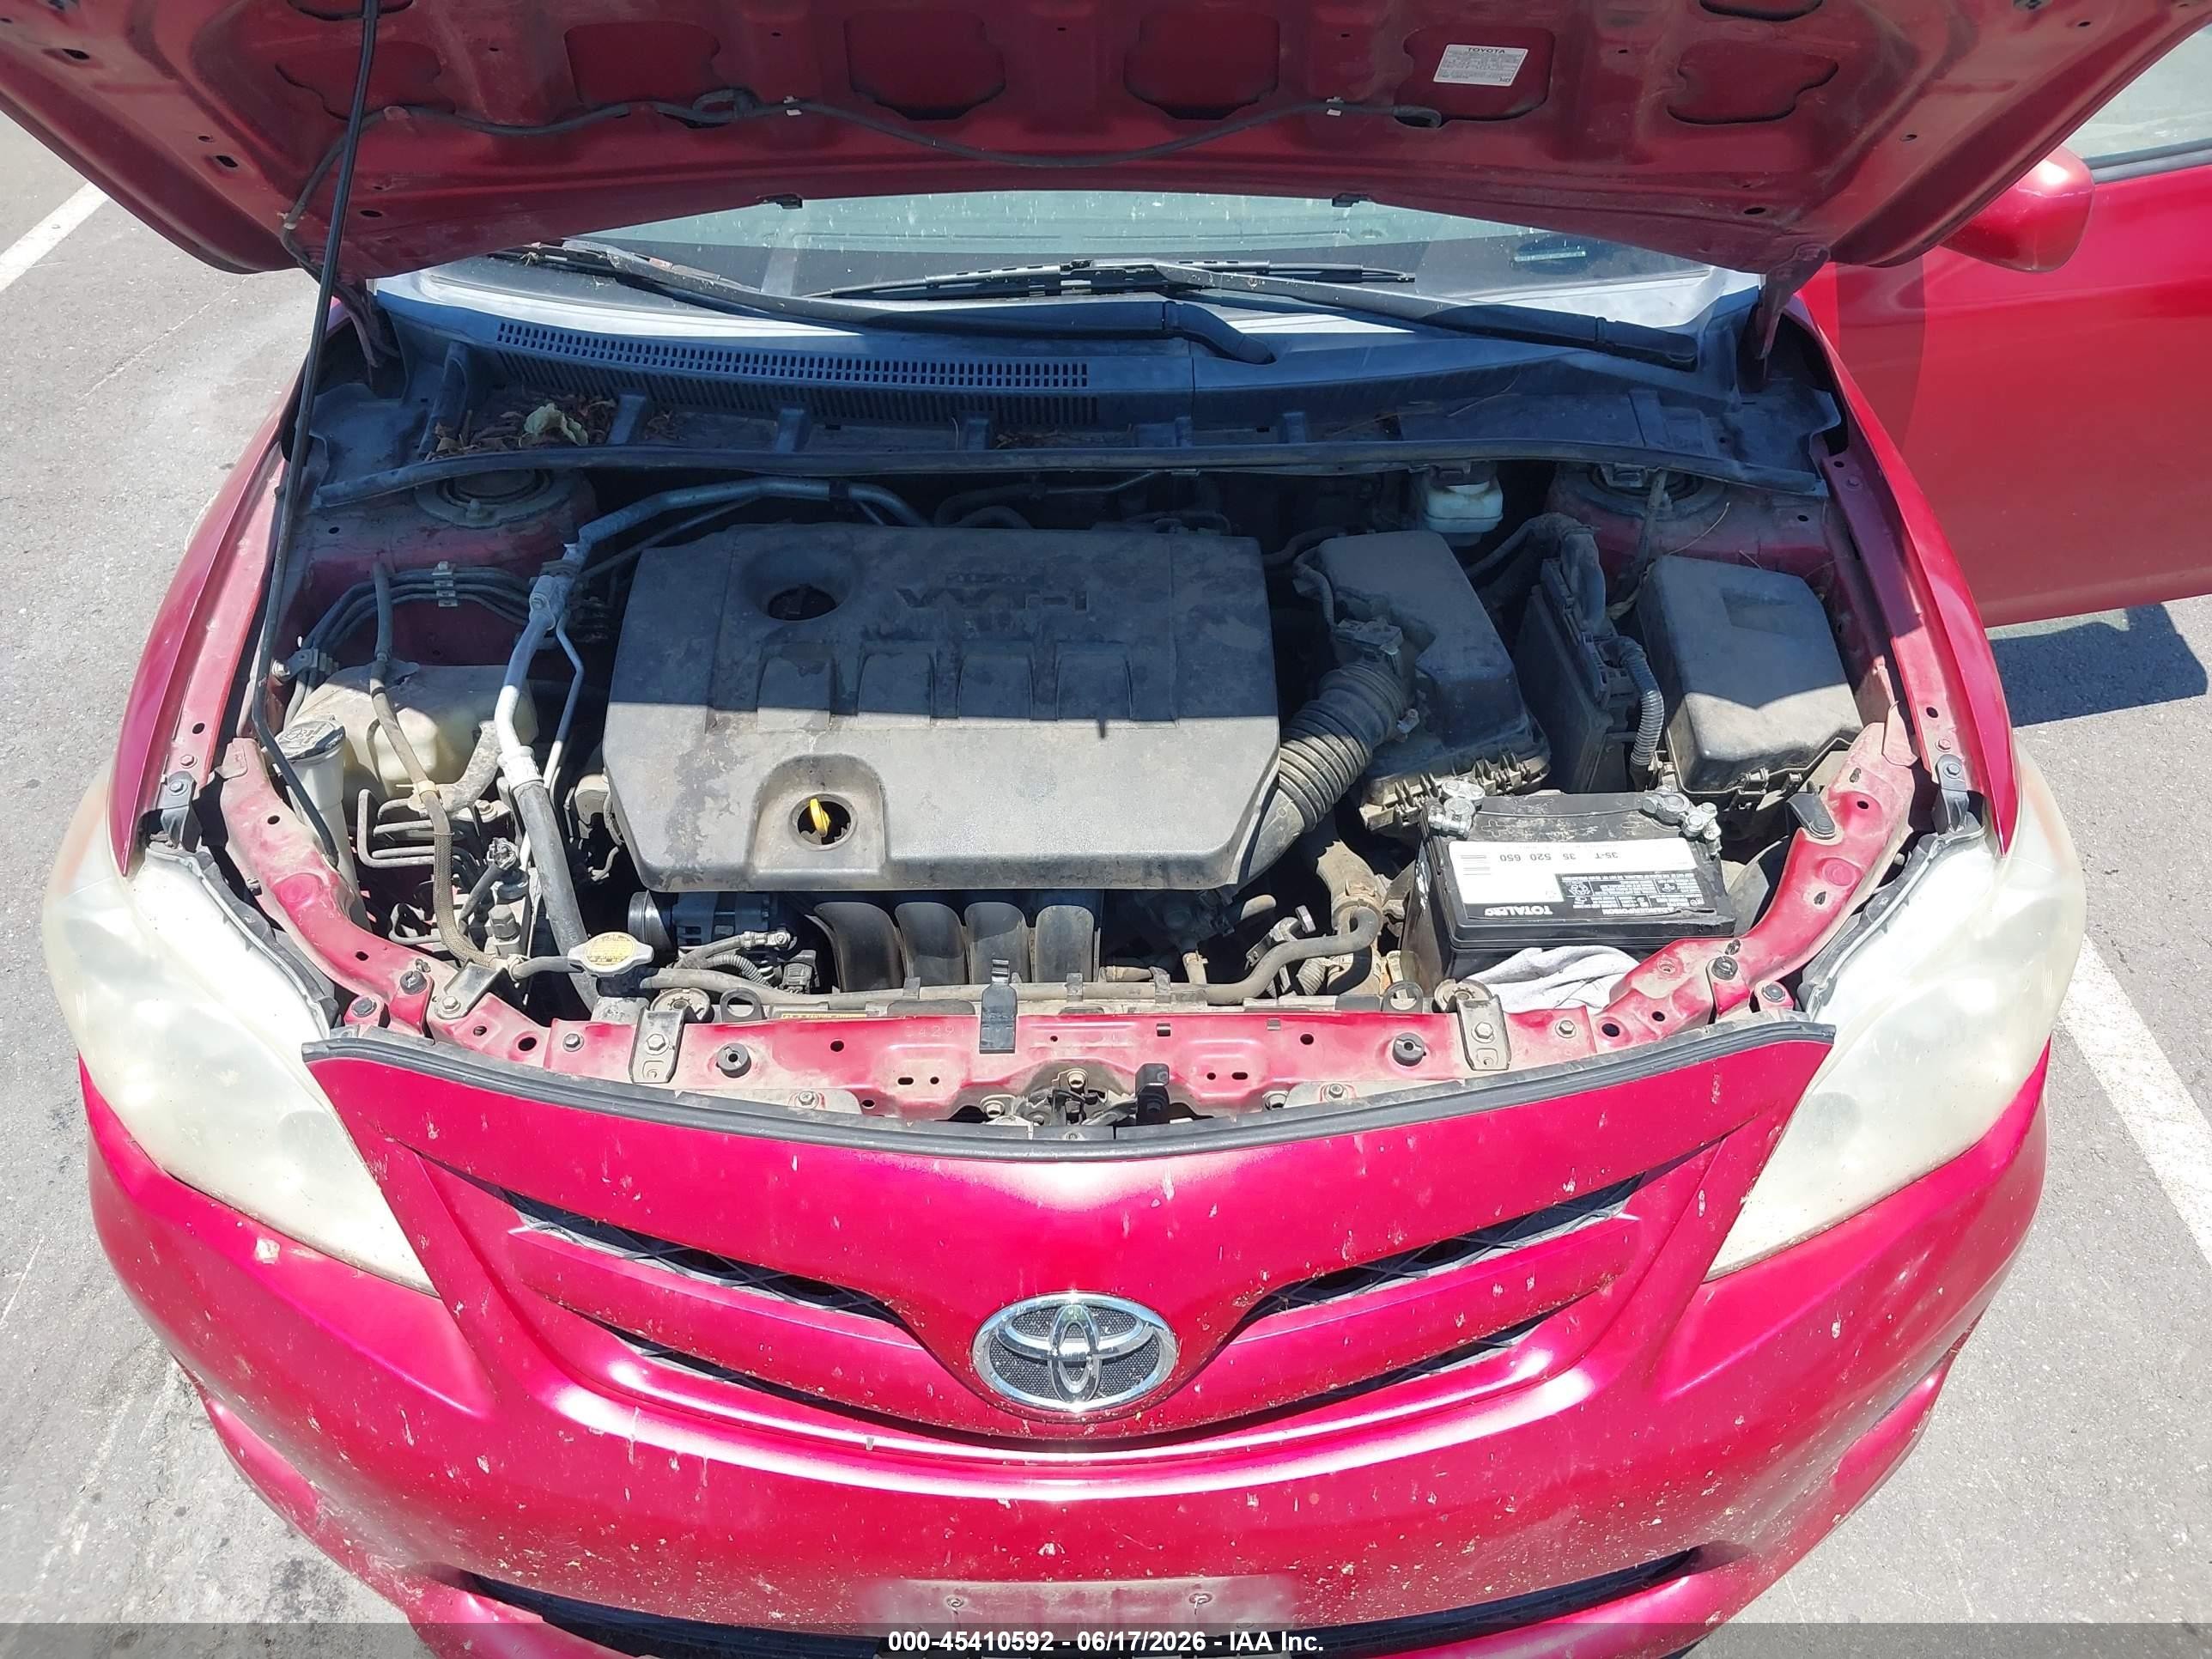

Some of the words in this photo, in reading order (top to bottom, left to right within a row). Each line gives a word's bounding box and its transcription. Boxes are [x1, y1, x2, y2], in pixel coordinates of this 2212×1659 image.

[1498, 854, 1522, 862] 650
[1528, 853, 1553, 861] 520
[1562, 852, 1577, 860] 35
[1595, 851, 1620, 860] 35-T
[1484, 905, 1553, 918] TOTALPRO
